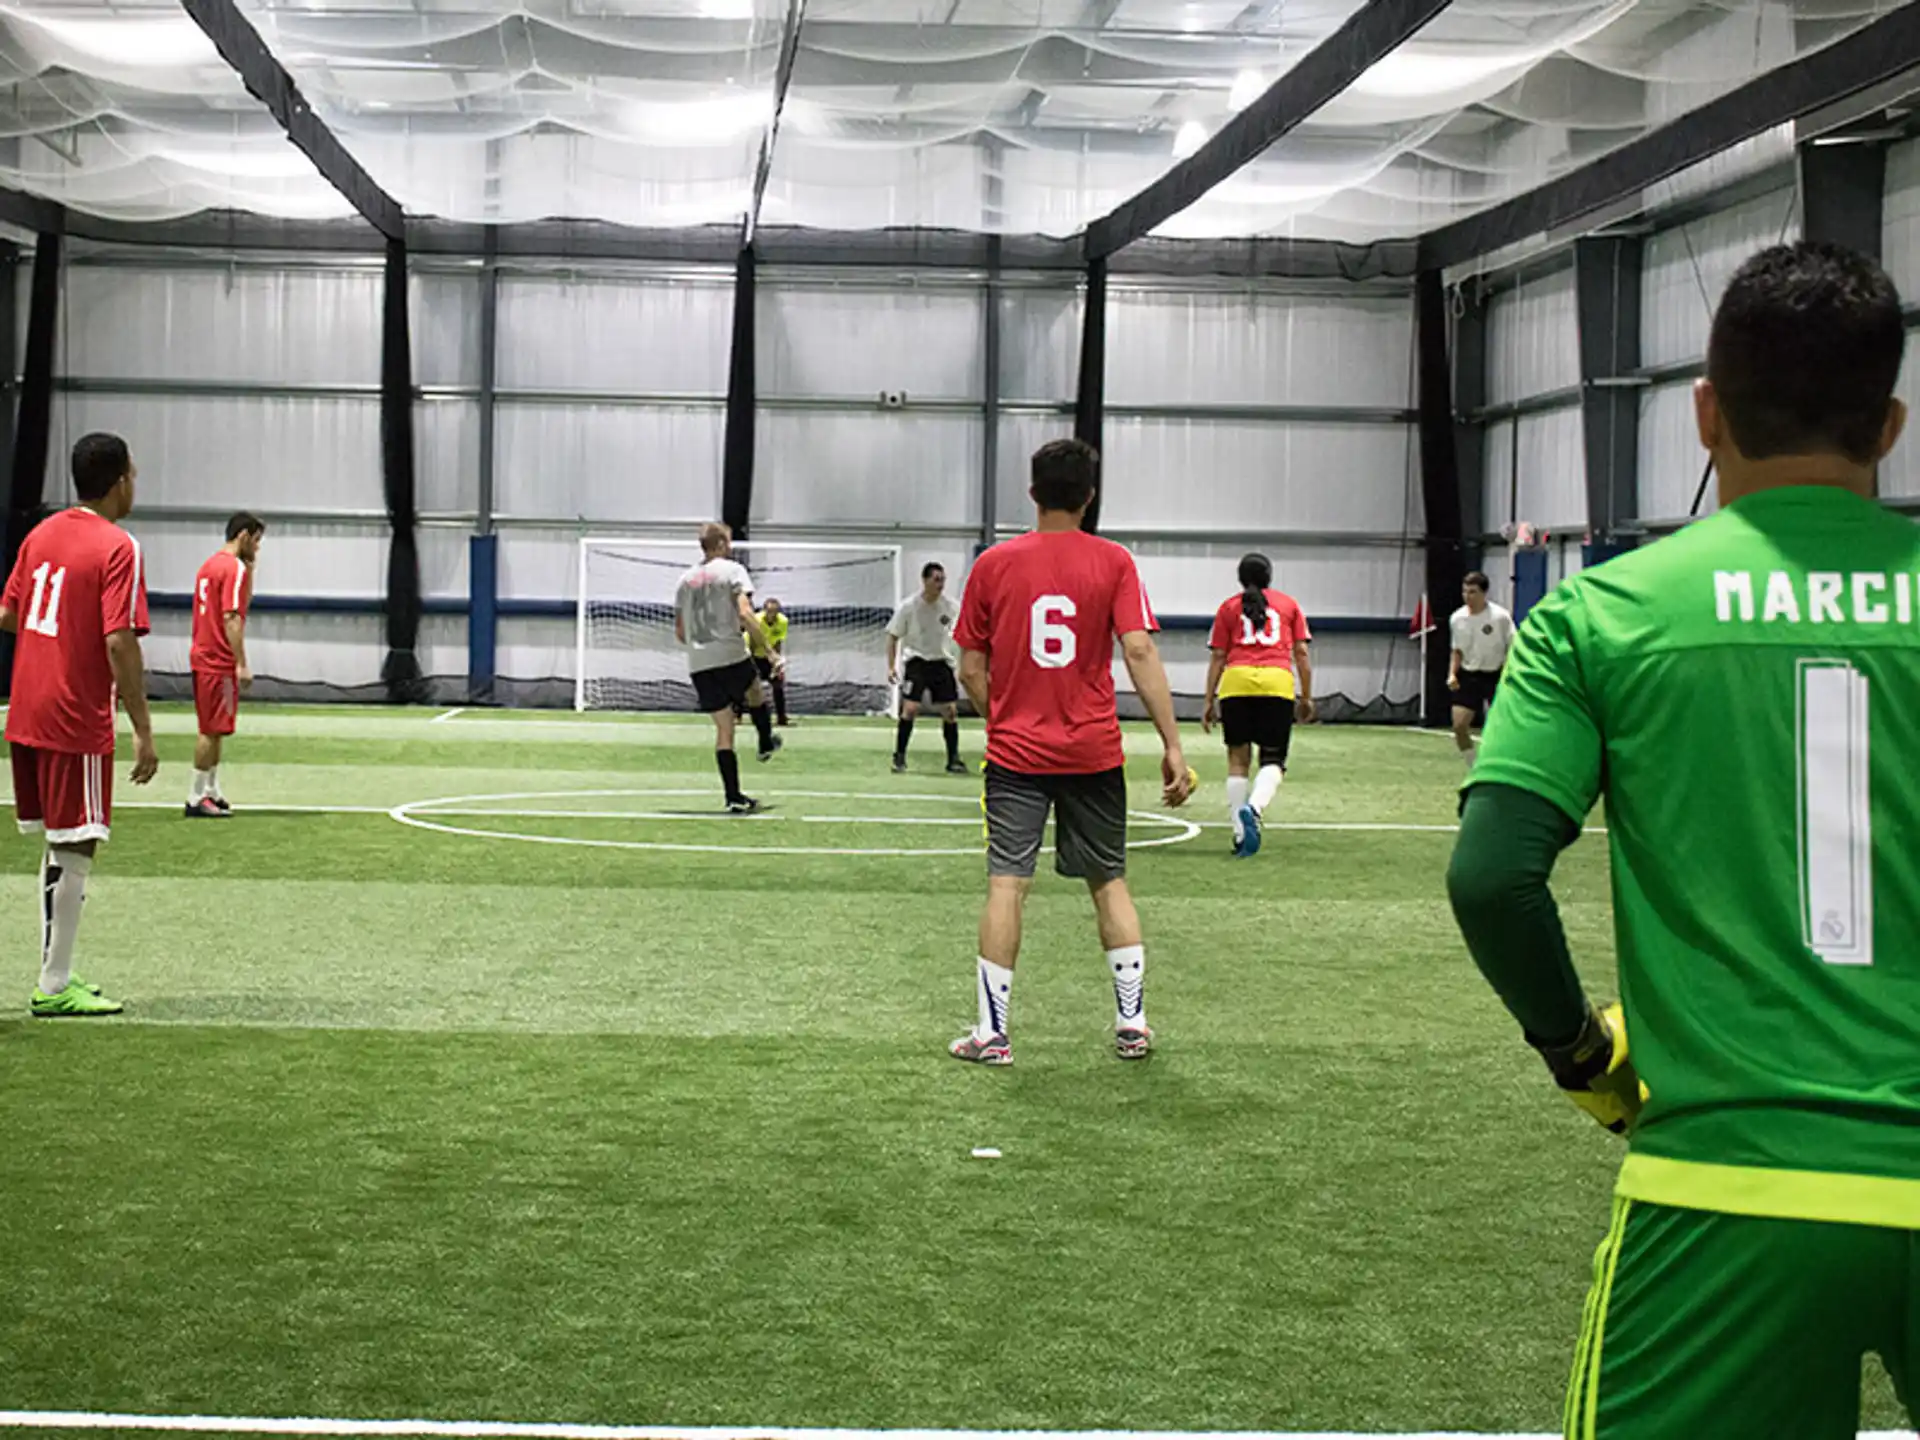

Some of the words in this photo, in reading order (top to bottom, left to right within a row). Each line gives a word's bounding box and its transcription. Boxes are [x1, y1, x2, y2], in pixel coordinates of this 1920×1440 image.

[24, 561, 66, 638] 11
[1030, 593, 1077, 668] 6
[1713, 570, 1920, 623] MARCI
[1796, 657, 1874, 966] 1
